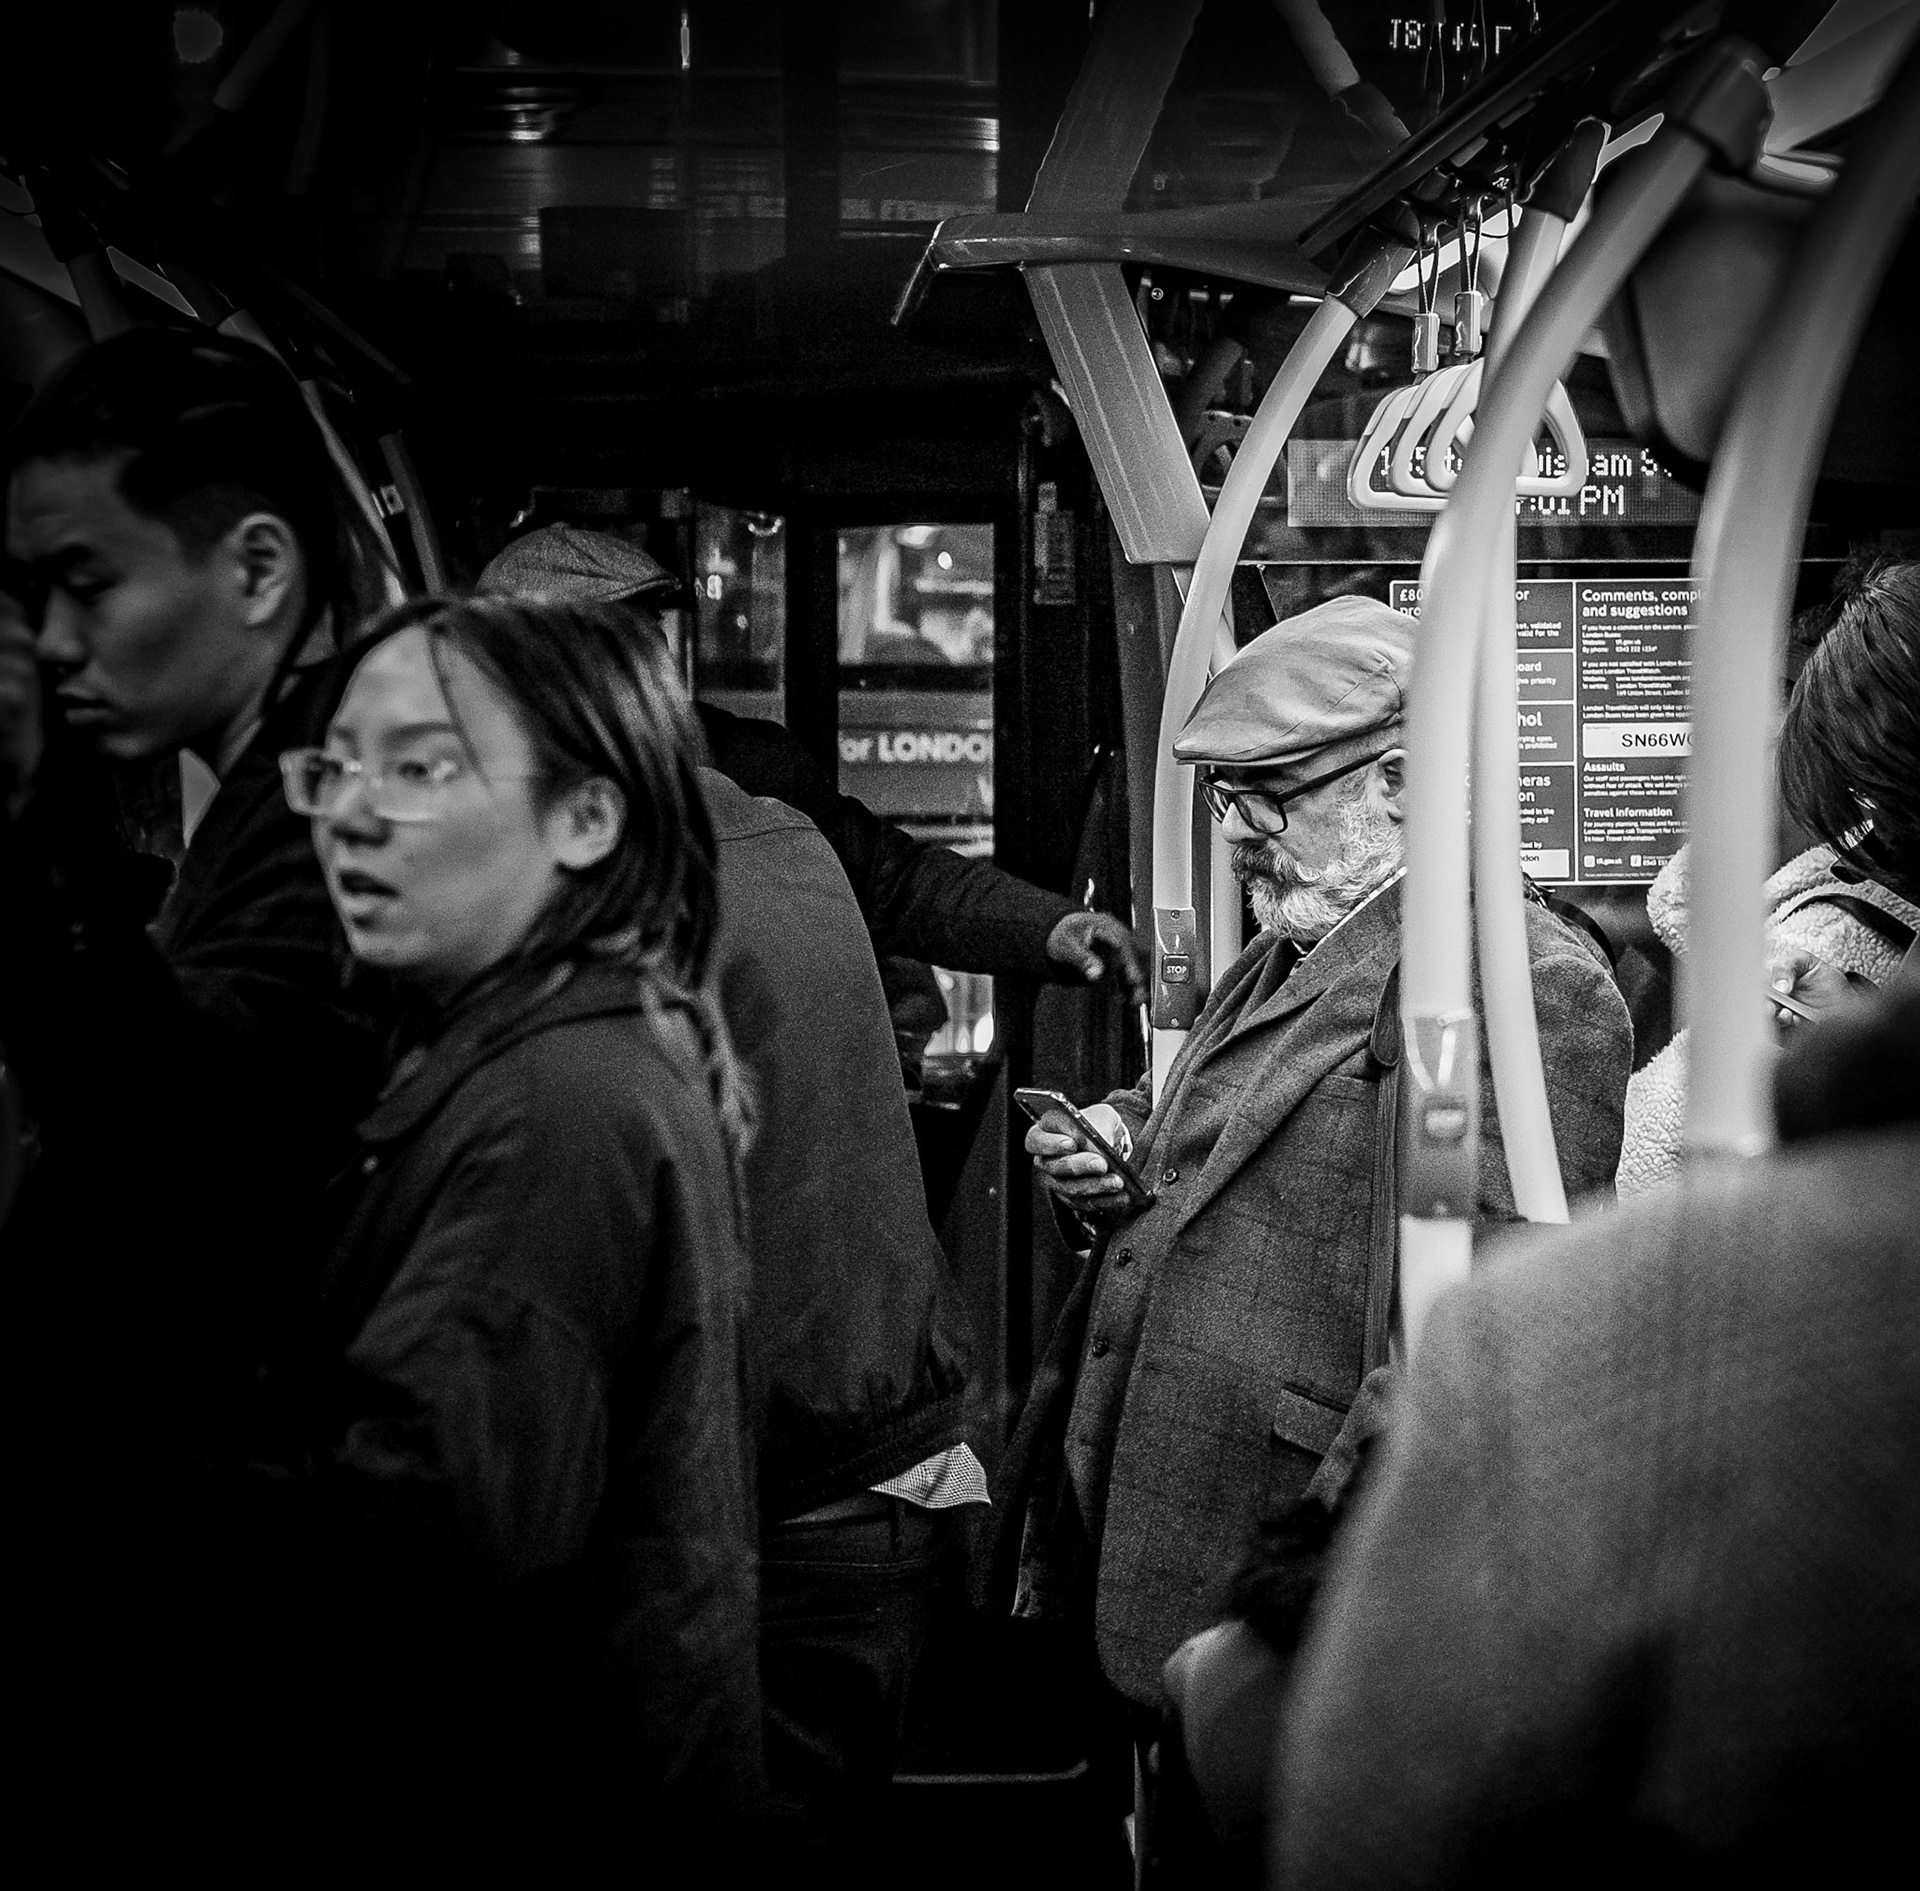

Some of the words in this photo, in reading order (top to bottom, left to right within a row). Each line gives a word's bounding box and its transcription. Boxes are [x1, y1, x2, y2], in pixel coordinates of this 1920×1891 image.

[1581, 485, 1625, 515] PM
[1582, 589, 1659, 602] Comments,
[1582, 603, 1608, 617] and
[1610, 603, 1688, 619] suggestions
[1535, 629, 1545, 637] for
[1547, 629, 1559, 637] the
[1530, 677, 1557, 686] priority
[838, 731, 873, 762] or
[878, 732, 993, 762] LONDO
[1525, 742, 1558, 750] prohibited
[1583, 761, 1625, 772] Assaults
[1518, 791, 1535, 802] on
[1543, 807, 1555, 815] the
[1583, 807, 1614, 818] Travel
[1536, 816, 1549, 824] and
[1166, 965, 1187, 974] STOP
